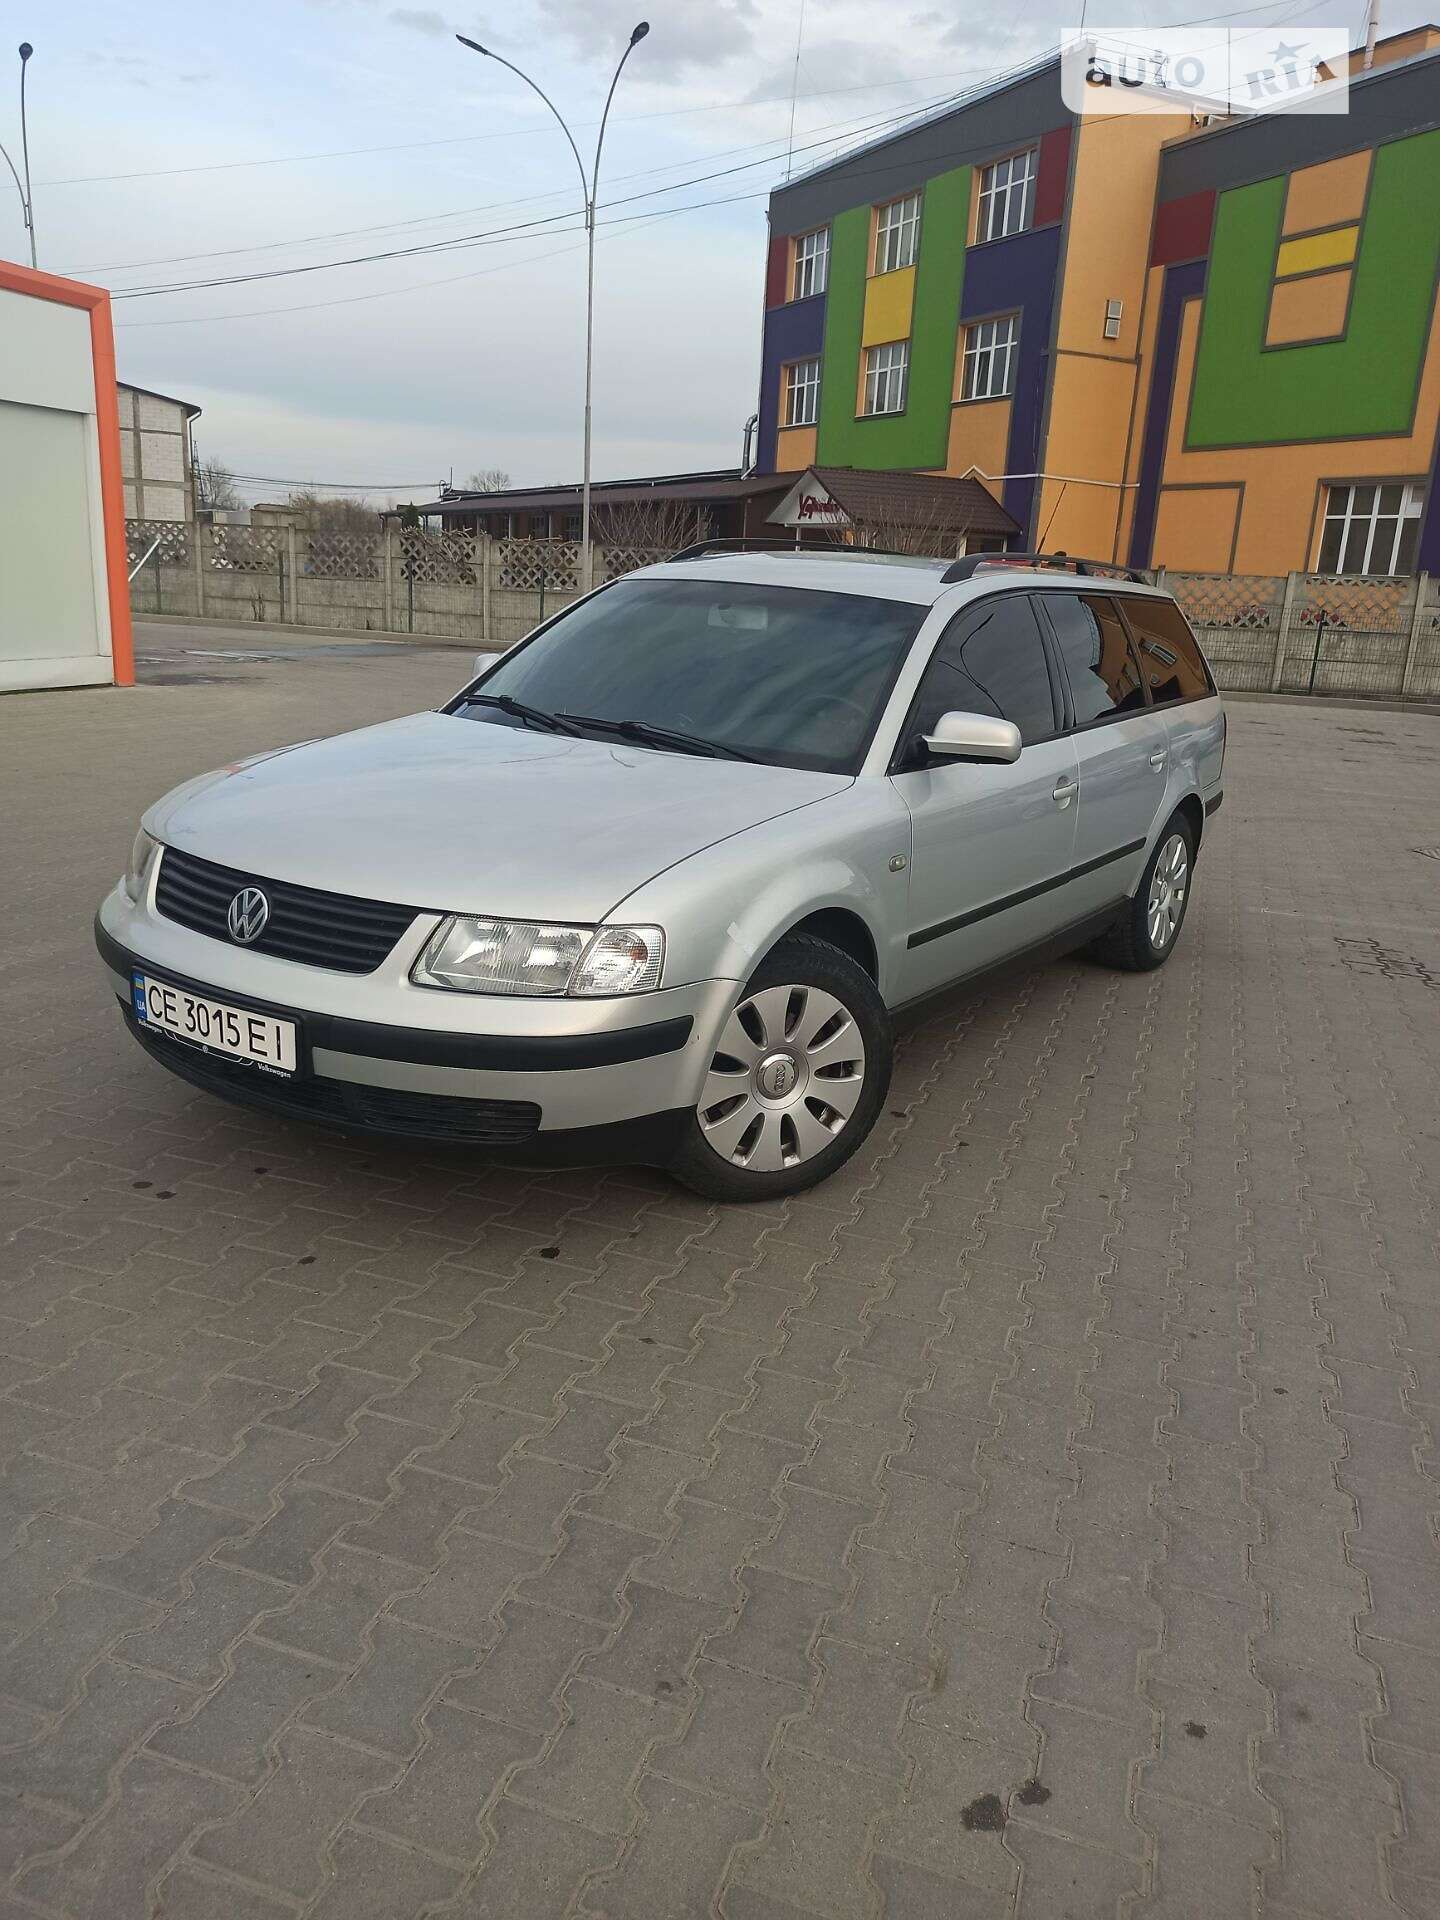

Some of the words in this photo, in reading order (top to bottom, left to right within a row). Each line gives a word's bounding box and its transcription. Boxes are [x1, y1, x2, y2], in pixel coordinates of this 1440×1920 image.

[137, 1000, 147, 1012] UA
[149, 985, 179, 1027] CE
[184, 998, 241, 1048] 3015
[248, 1017, 281, 1061] EI
[257, 1062, 292, 1079] Volkswagen
